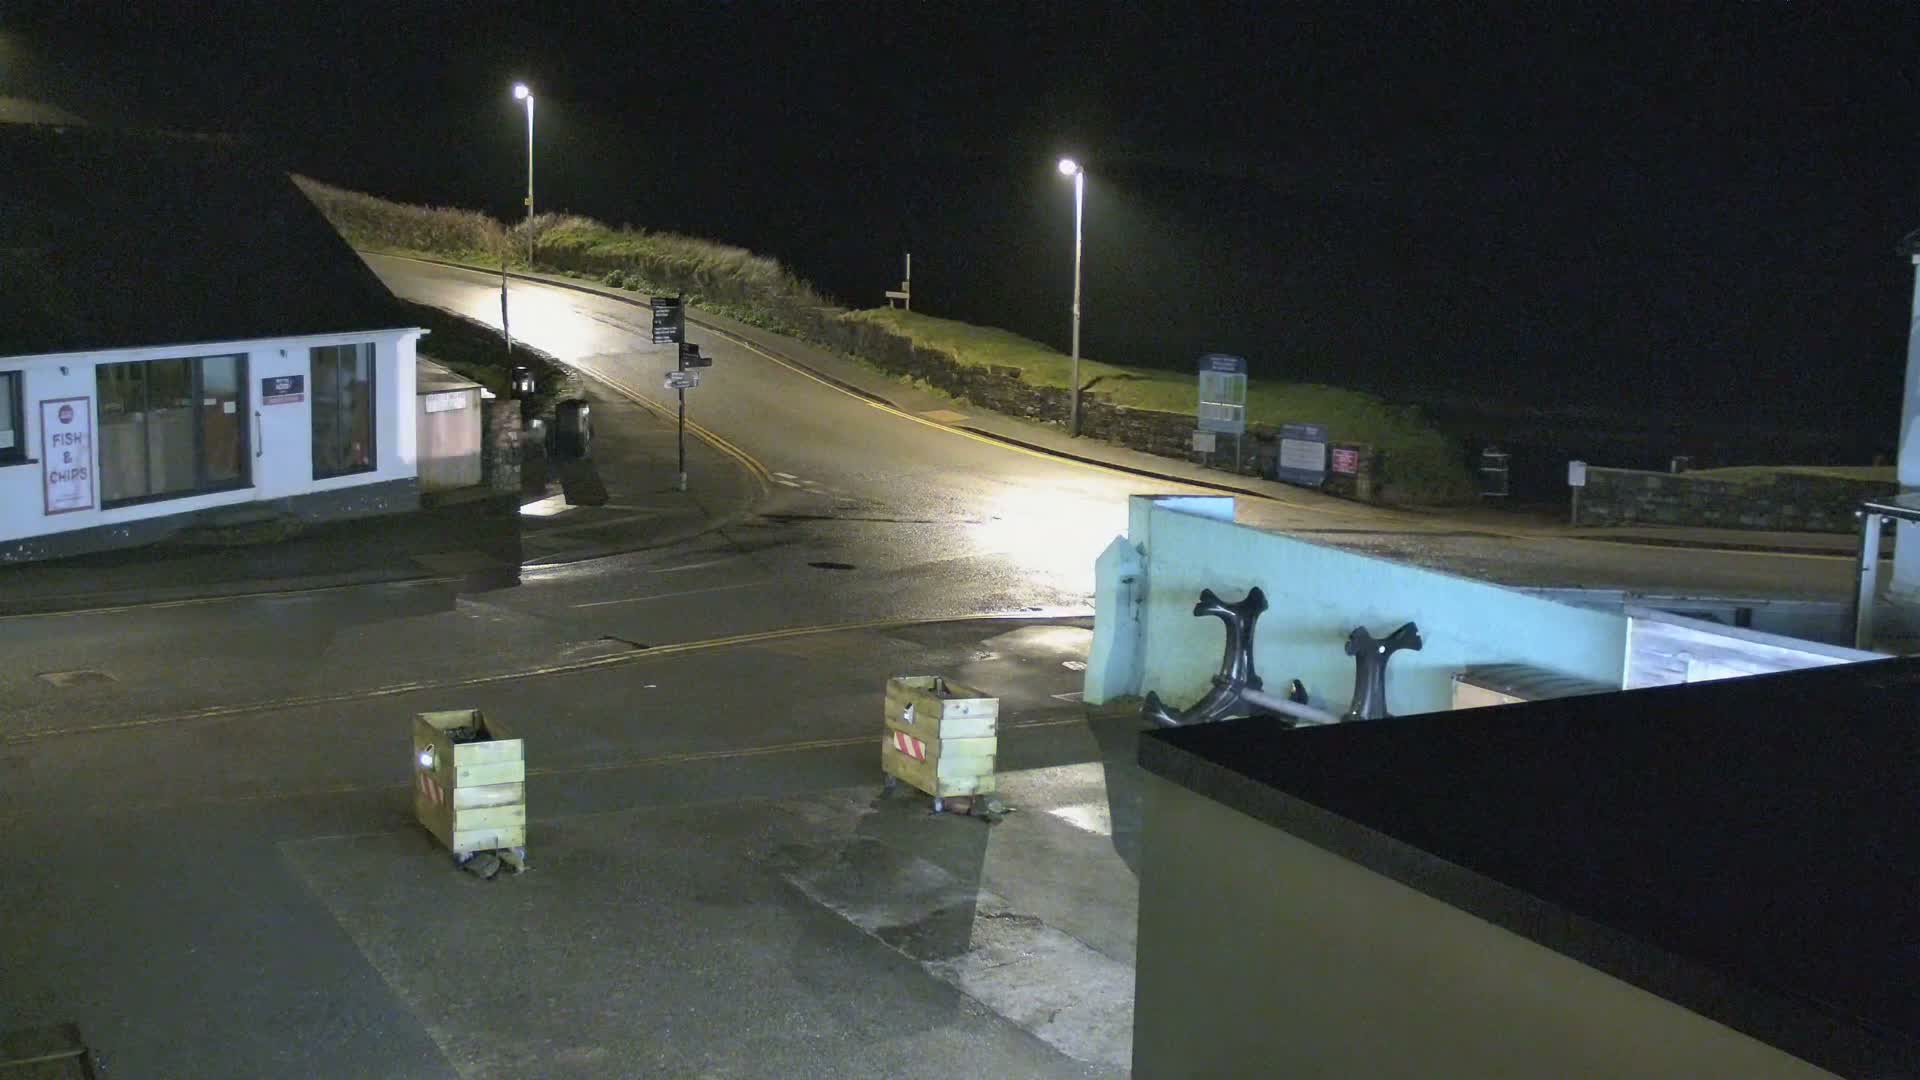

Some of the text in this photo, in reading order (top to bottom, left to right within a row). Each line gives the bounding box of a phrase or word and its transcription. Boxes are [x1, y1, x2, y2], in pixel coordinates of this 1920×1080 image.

[52, 432, 82, 448] FISH
[63, 451, 72, 464] &
[49, 468, 88, 484] CHIPS
